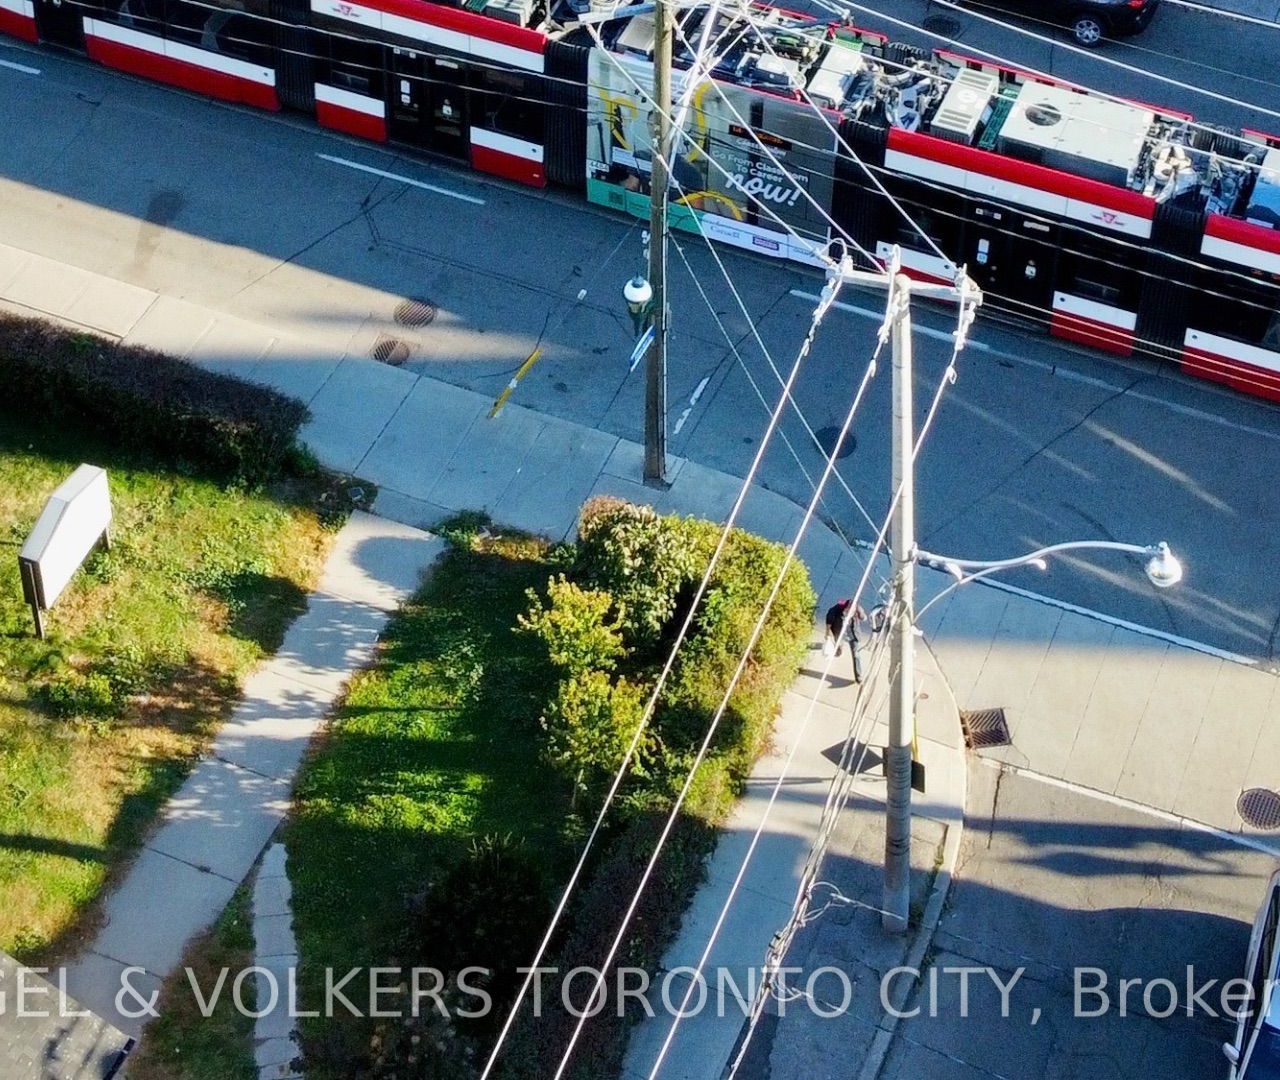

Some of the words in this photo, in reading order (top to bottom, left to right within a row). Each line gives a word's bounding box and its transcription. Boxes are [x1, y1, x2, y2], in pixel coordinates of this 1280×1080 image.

[711, 150, 726, 160] Go
[727, 154, 754, 168] From
[736, 164, 749, 174] To
[749, 168, 783, 183] Career
[725, 172, 800, 207] now!
